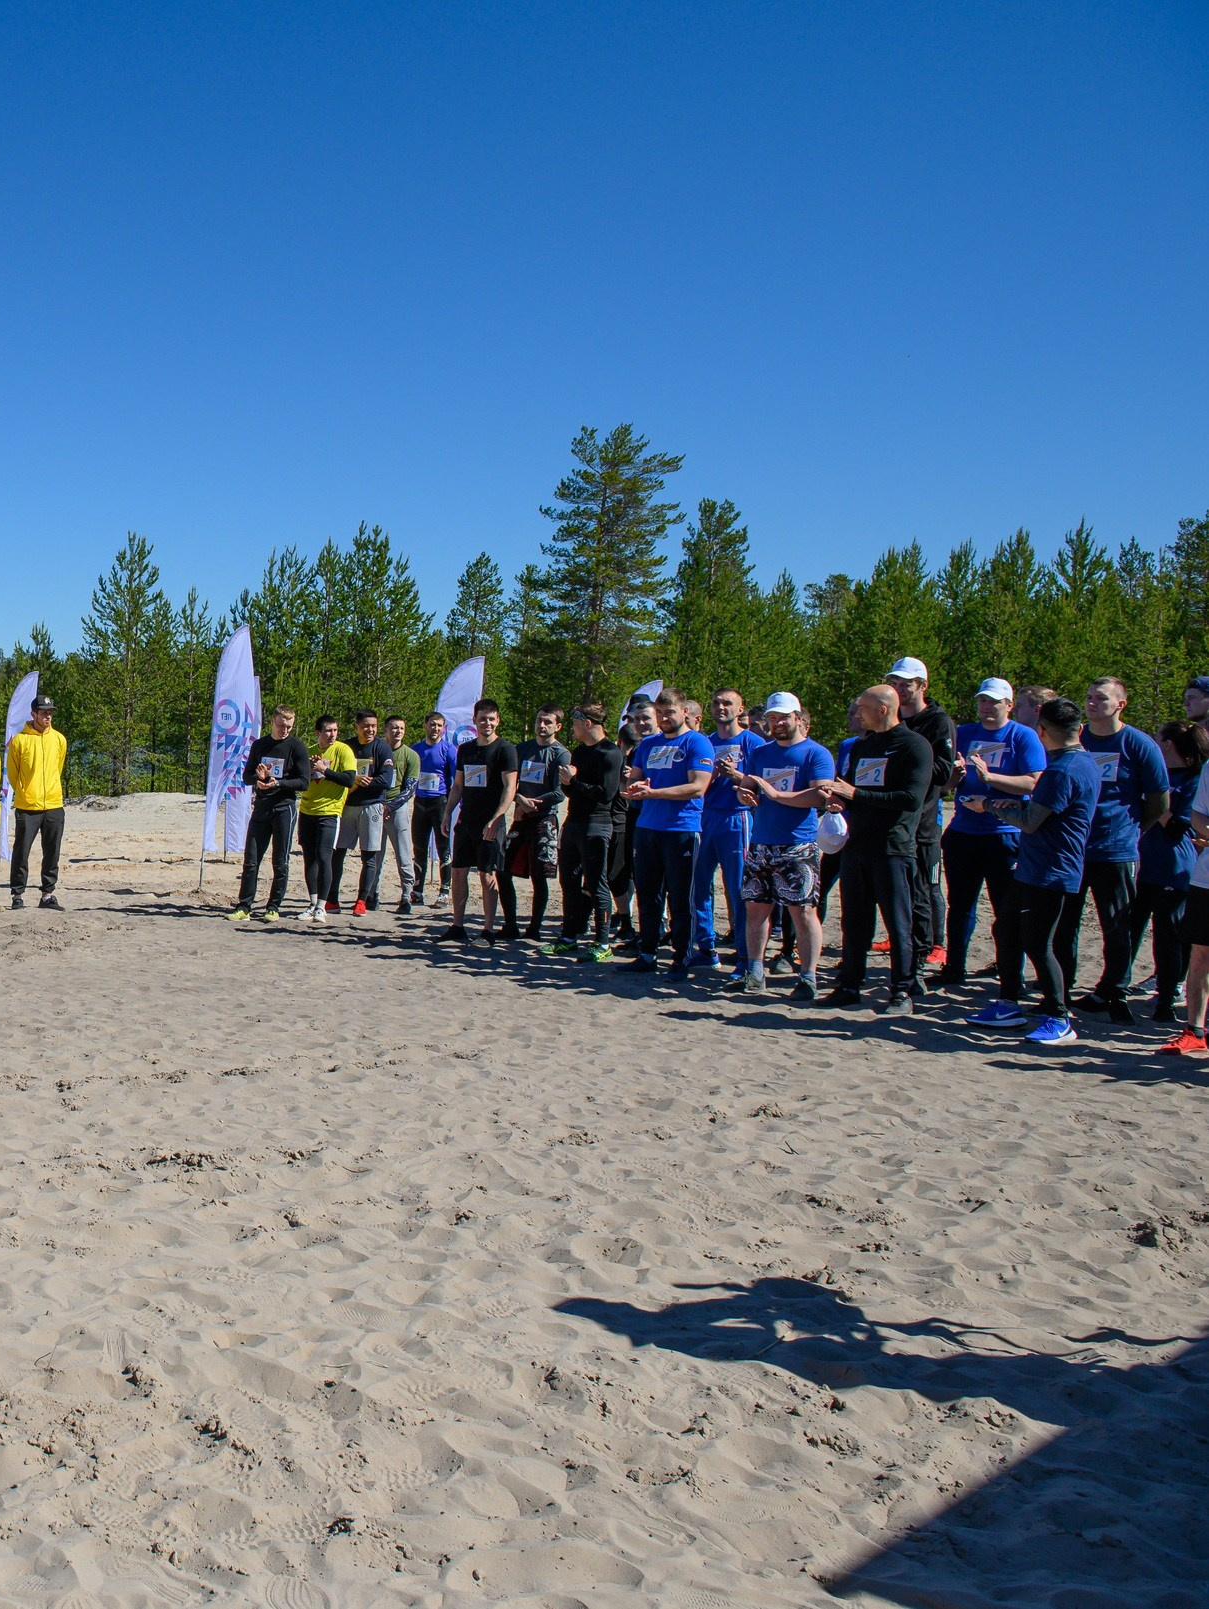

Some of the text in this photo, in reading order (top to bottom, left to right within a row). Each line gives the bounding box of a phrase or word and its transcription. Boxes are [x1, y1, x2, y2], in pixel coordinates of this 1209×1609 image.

[274, 765, 280, 776] 5
[534, 770, 541, 781] 4
[874, 768, 881, 783] 2
[1101, 763, 1112, 778] 2
[476, 773, 482, 784] 1
[780, 778, 789, 792] 3
